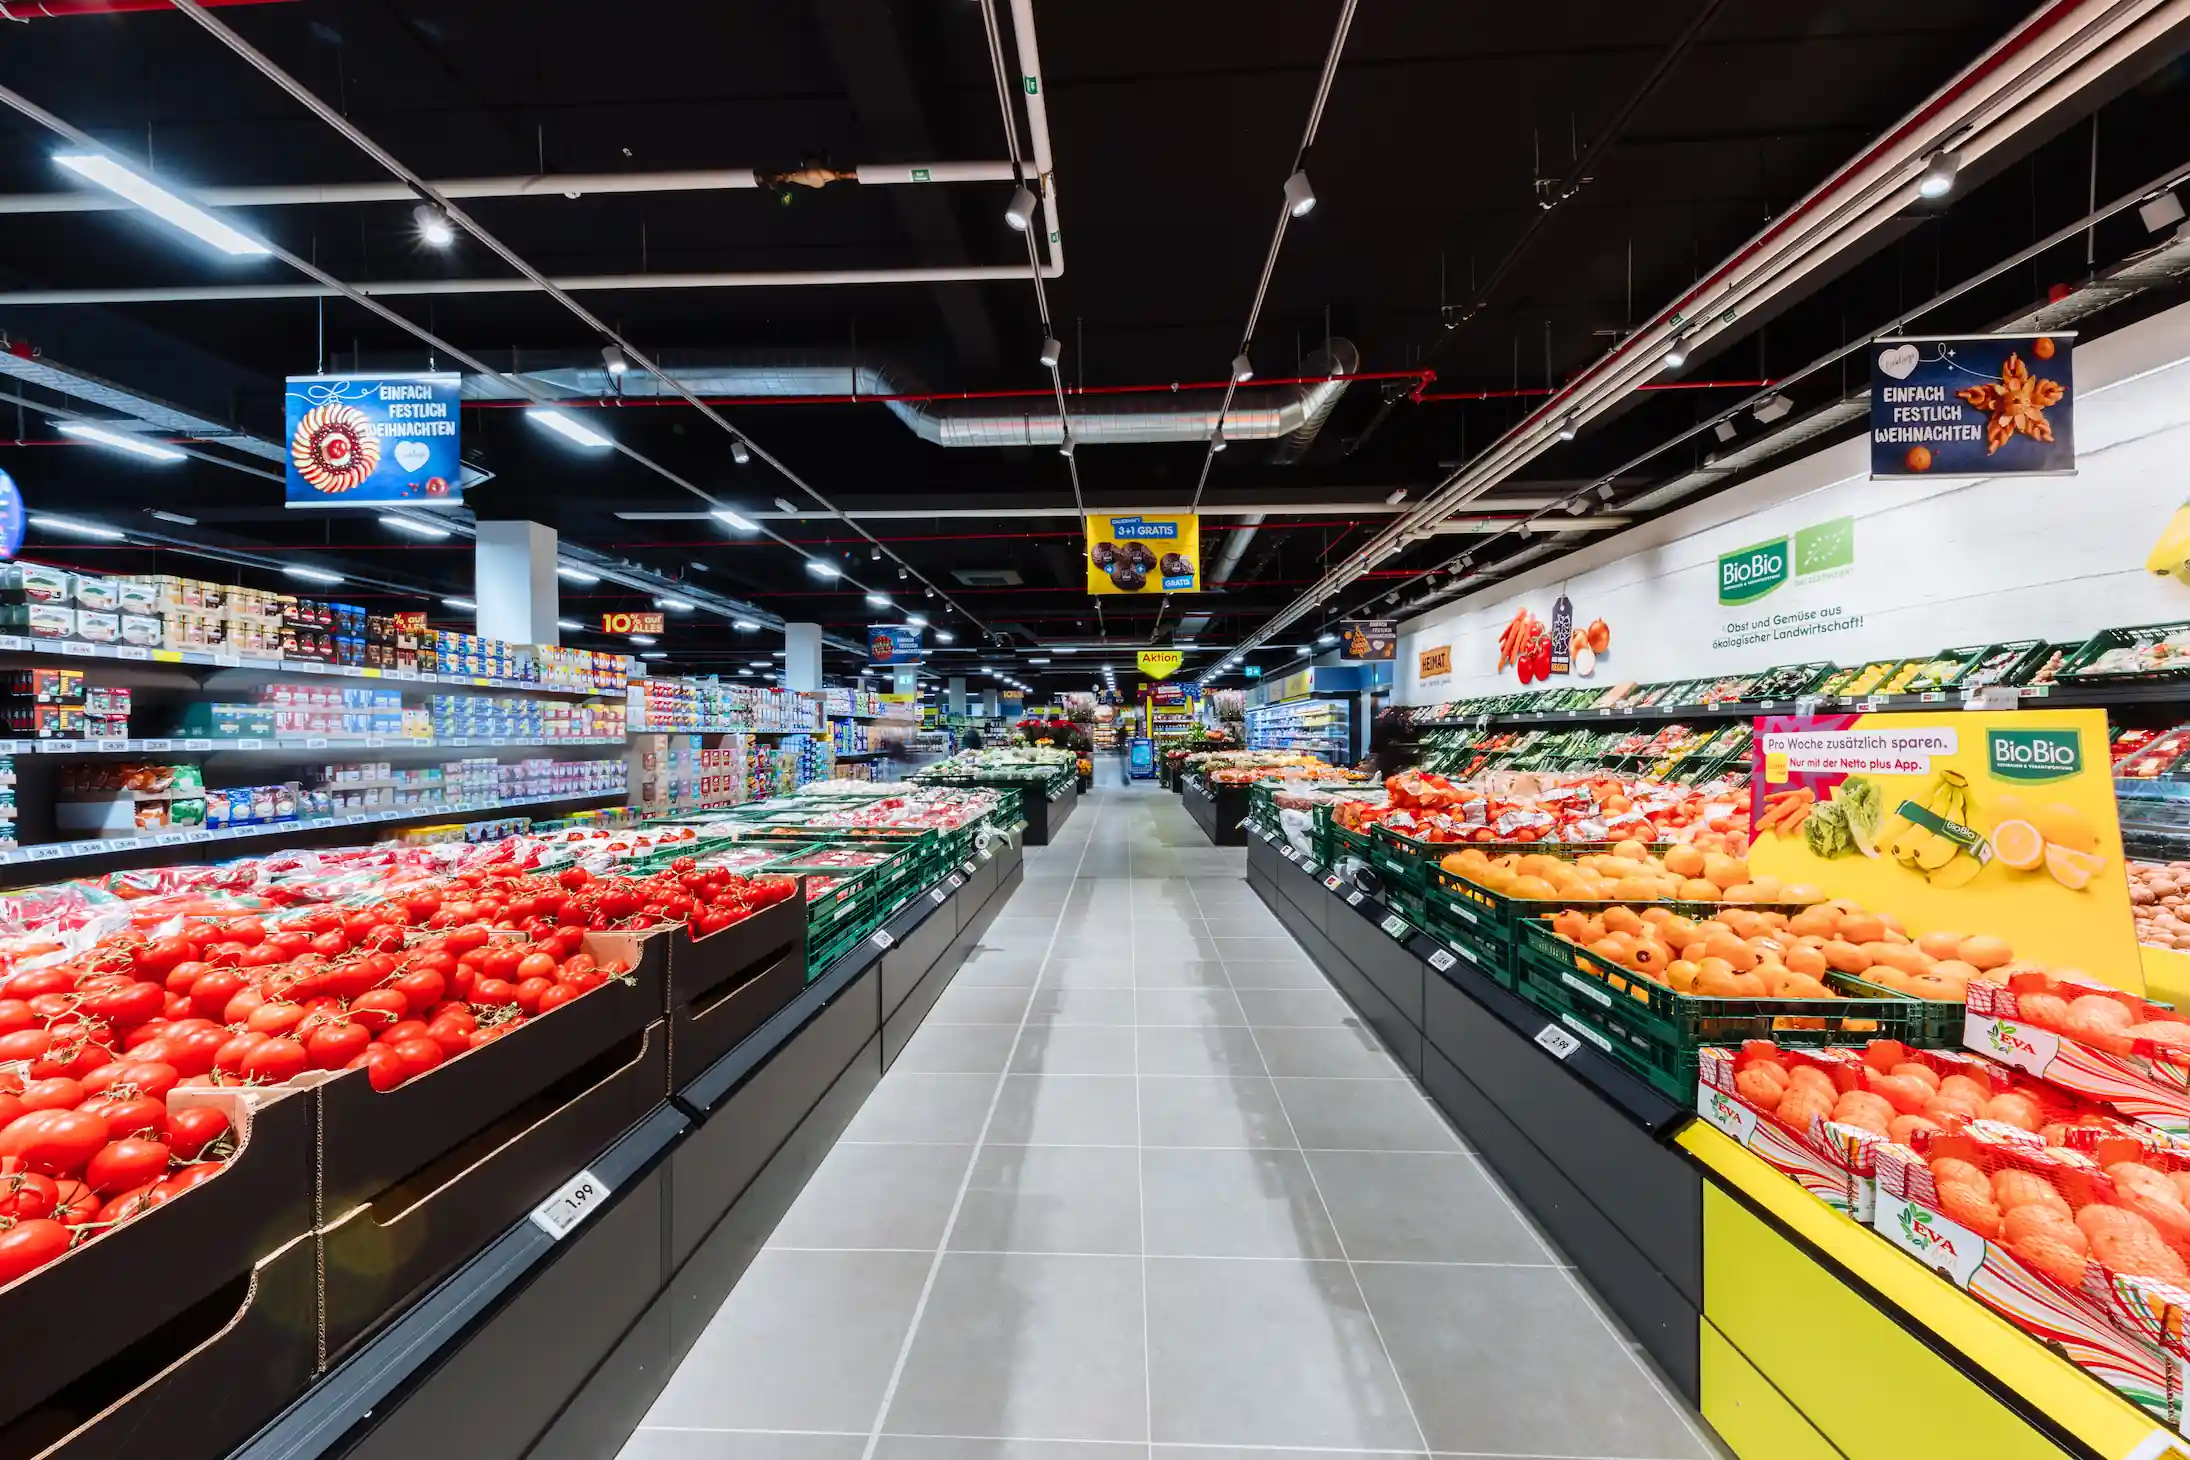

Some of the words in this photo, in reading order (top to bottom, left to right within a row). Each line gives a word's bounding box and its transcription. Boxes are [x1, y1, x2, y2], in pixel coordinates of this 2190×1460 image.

[379, 386, 432, 400] EINFACH
[1883, 386, 1945, 403] EINFACH
[389, 403, 447, 418] FESTLICH
[1894, 405, 1962, 423] FESTLICH
[365, 421, 456, 437] WEIHNACHTEN
[1875, 425, 1982, 443] WEIHNACHTEN
[1118, 526, 1135, 536] 3+1
[1137, 526, 1174, 536] GRATIS
[1164, 579, 1190, 588] GRATIS
[632, 624, 662, 632] ALLES
[1727, 622, 1749, 633] Obst
[1752, 618, 1770, 629] und
[1773, 611, 1817, 625] Gemüse
[1820, 606, 1842, 617] aus
[1712, 633, 1772, 649] ökologischer
[1773, 616, 1864, 640] Landwirtschaft!
[1142, 652, 1178, 663] Aktion
[1422, 653, 1445, 672] HEIMAT
[1768, 739, 1785, 750] Pro
[1787, 737, 1823, 749] Woche
[1827, 736, 1887, 750] zusätzlich
[1892, 737, 1948, 753] sparen.
[1790, 758, 1804, 767] Nur
[1807, 758, 1820, 767] mit
[1822, 758, 1838, 768] der
[1840, 758, 1866, 769] Netto
[1869, 759, 1891, 772] plus
[1894, 759, 1922, 772] App.
[1552, 1036, 1569, 1050] 2.99
[2000, 1032, 2036, 1055] EVA
[1718, 1102, 1742, 1124] EVA
[564, 1184, 593, 1209] 1.99
[1913, 1219, 1958, 1257] EVA
